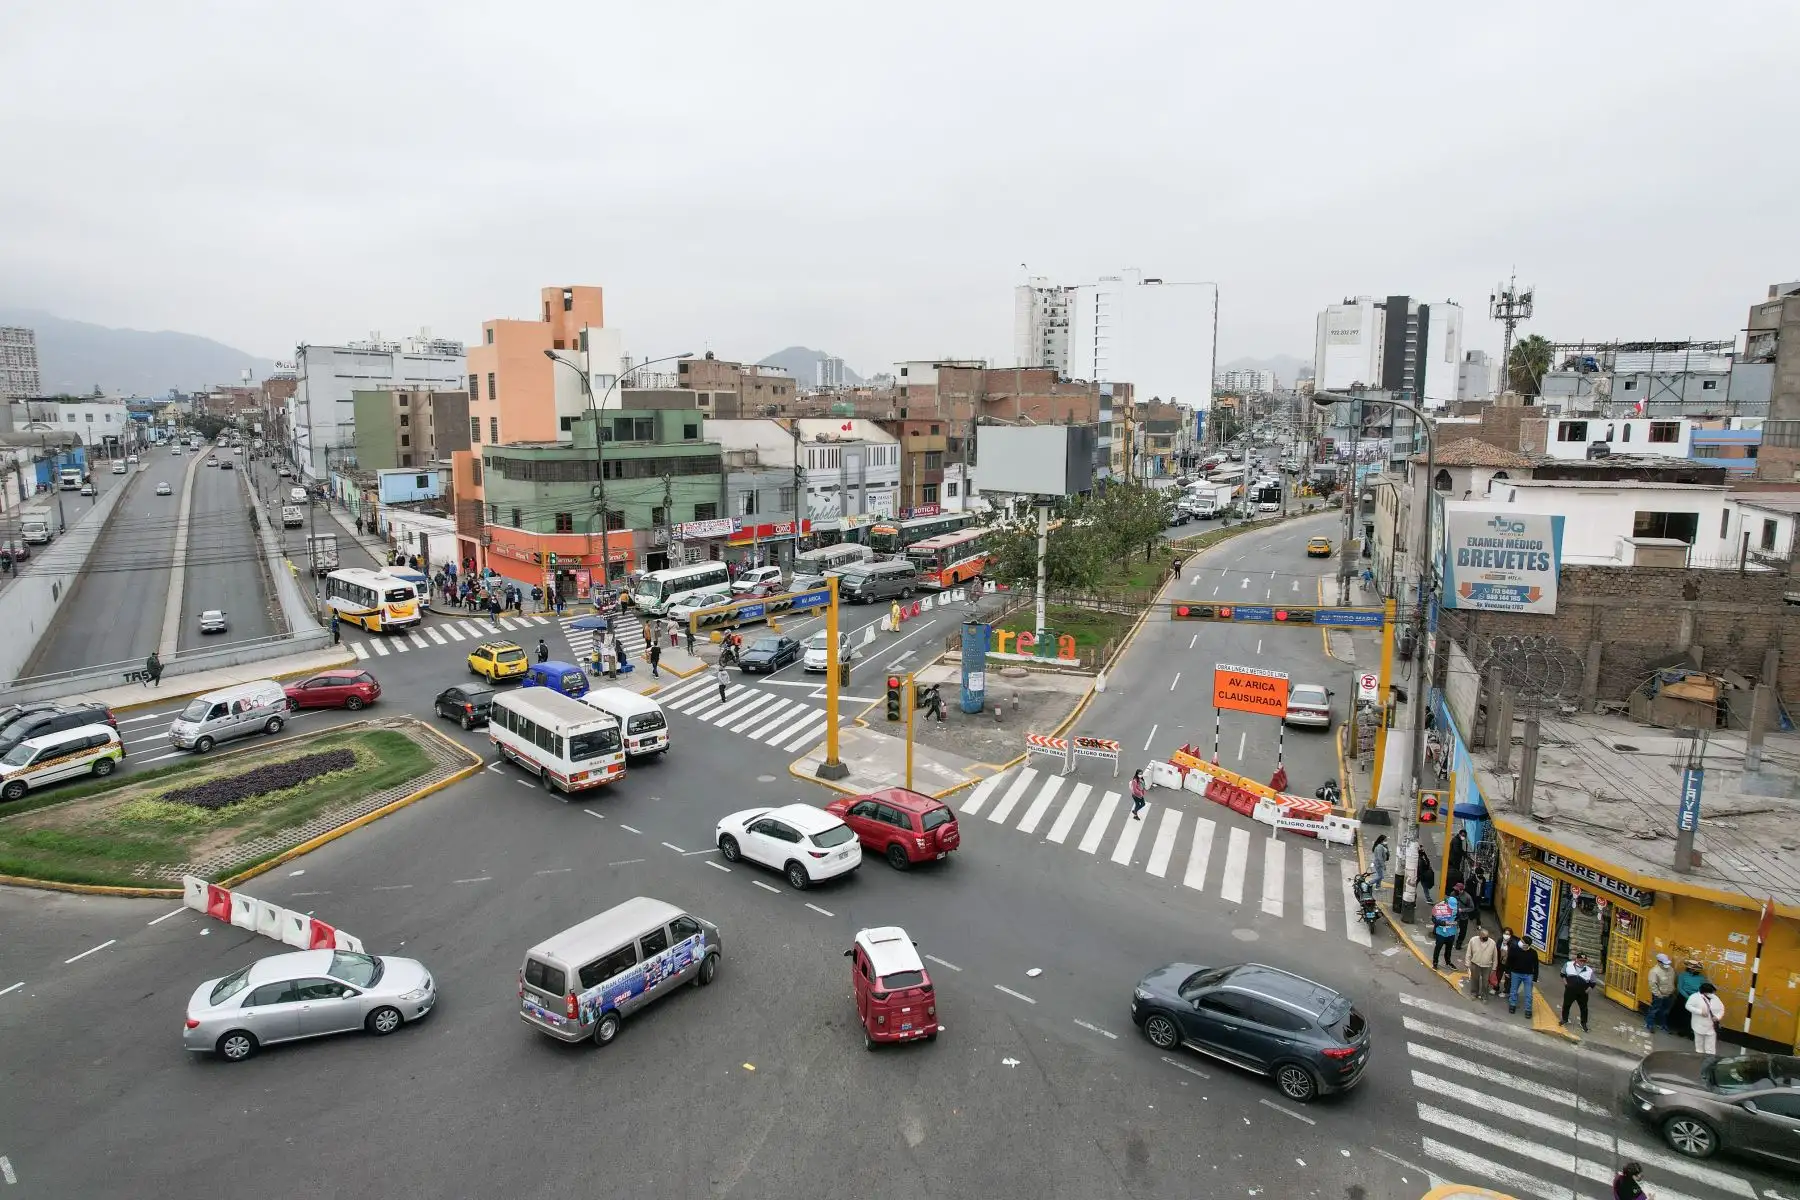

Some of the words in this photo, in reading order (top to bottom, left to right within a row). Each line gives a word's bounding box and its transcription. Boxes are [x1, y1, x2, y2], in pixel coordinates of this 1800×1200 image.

[1467, 537, 1504, 548] EXAMEN
[1506, 538, 1542, 550] MÉDICO
[1457, 548, 1550, 572] BREVETES
[1228, 678, 1243, 687] AV.
[1245, 680, 1276, 692] ARICA
[1218, 690, 1282, 707] CLAUSURADA
[1027, 745, 1048, 754] PELIGRO
[1074, 749, 1097, 757] PELIGRO
[1276, 820, 1304, 828] PELIGRO
[1546, 852, 1644, 900] FERRETERIA
[1530, 886, 1547, 940] LLAVES
